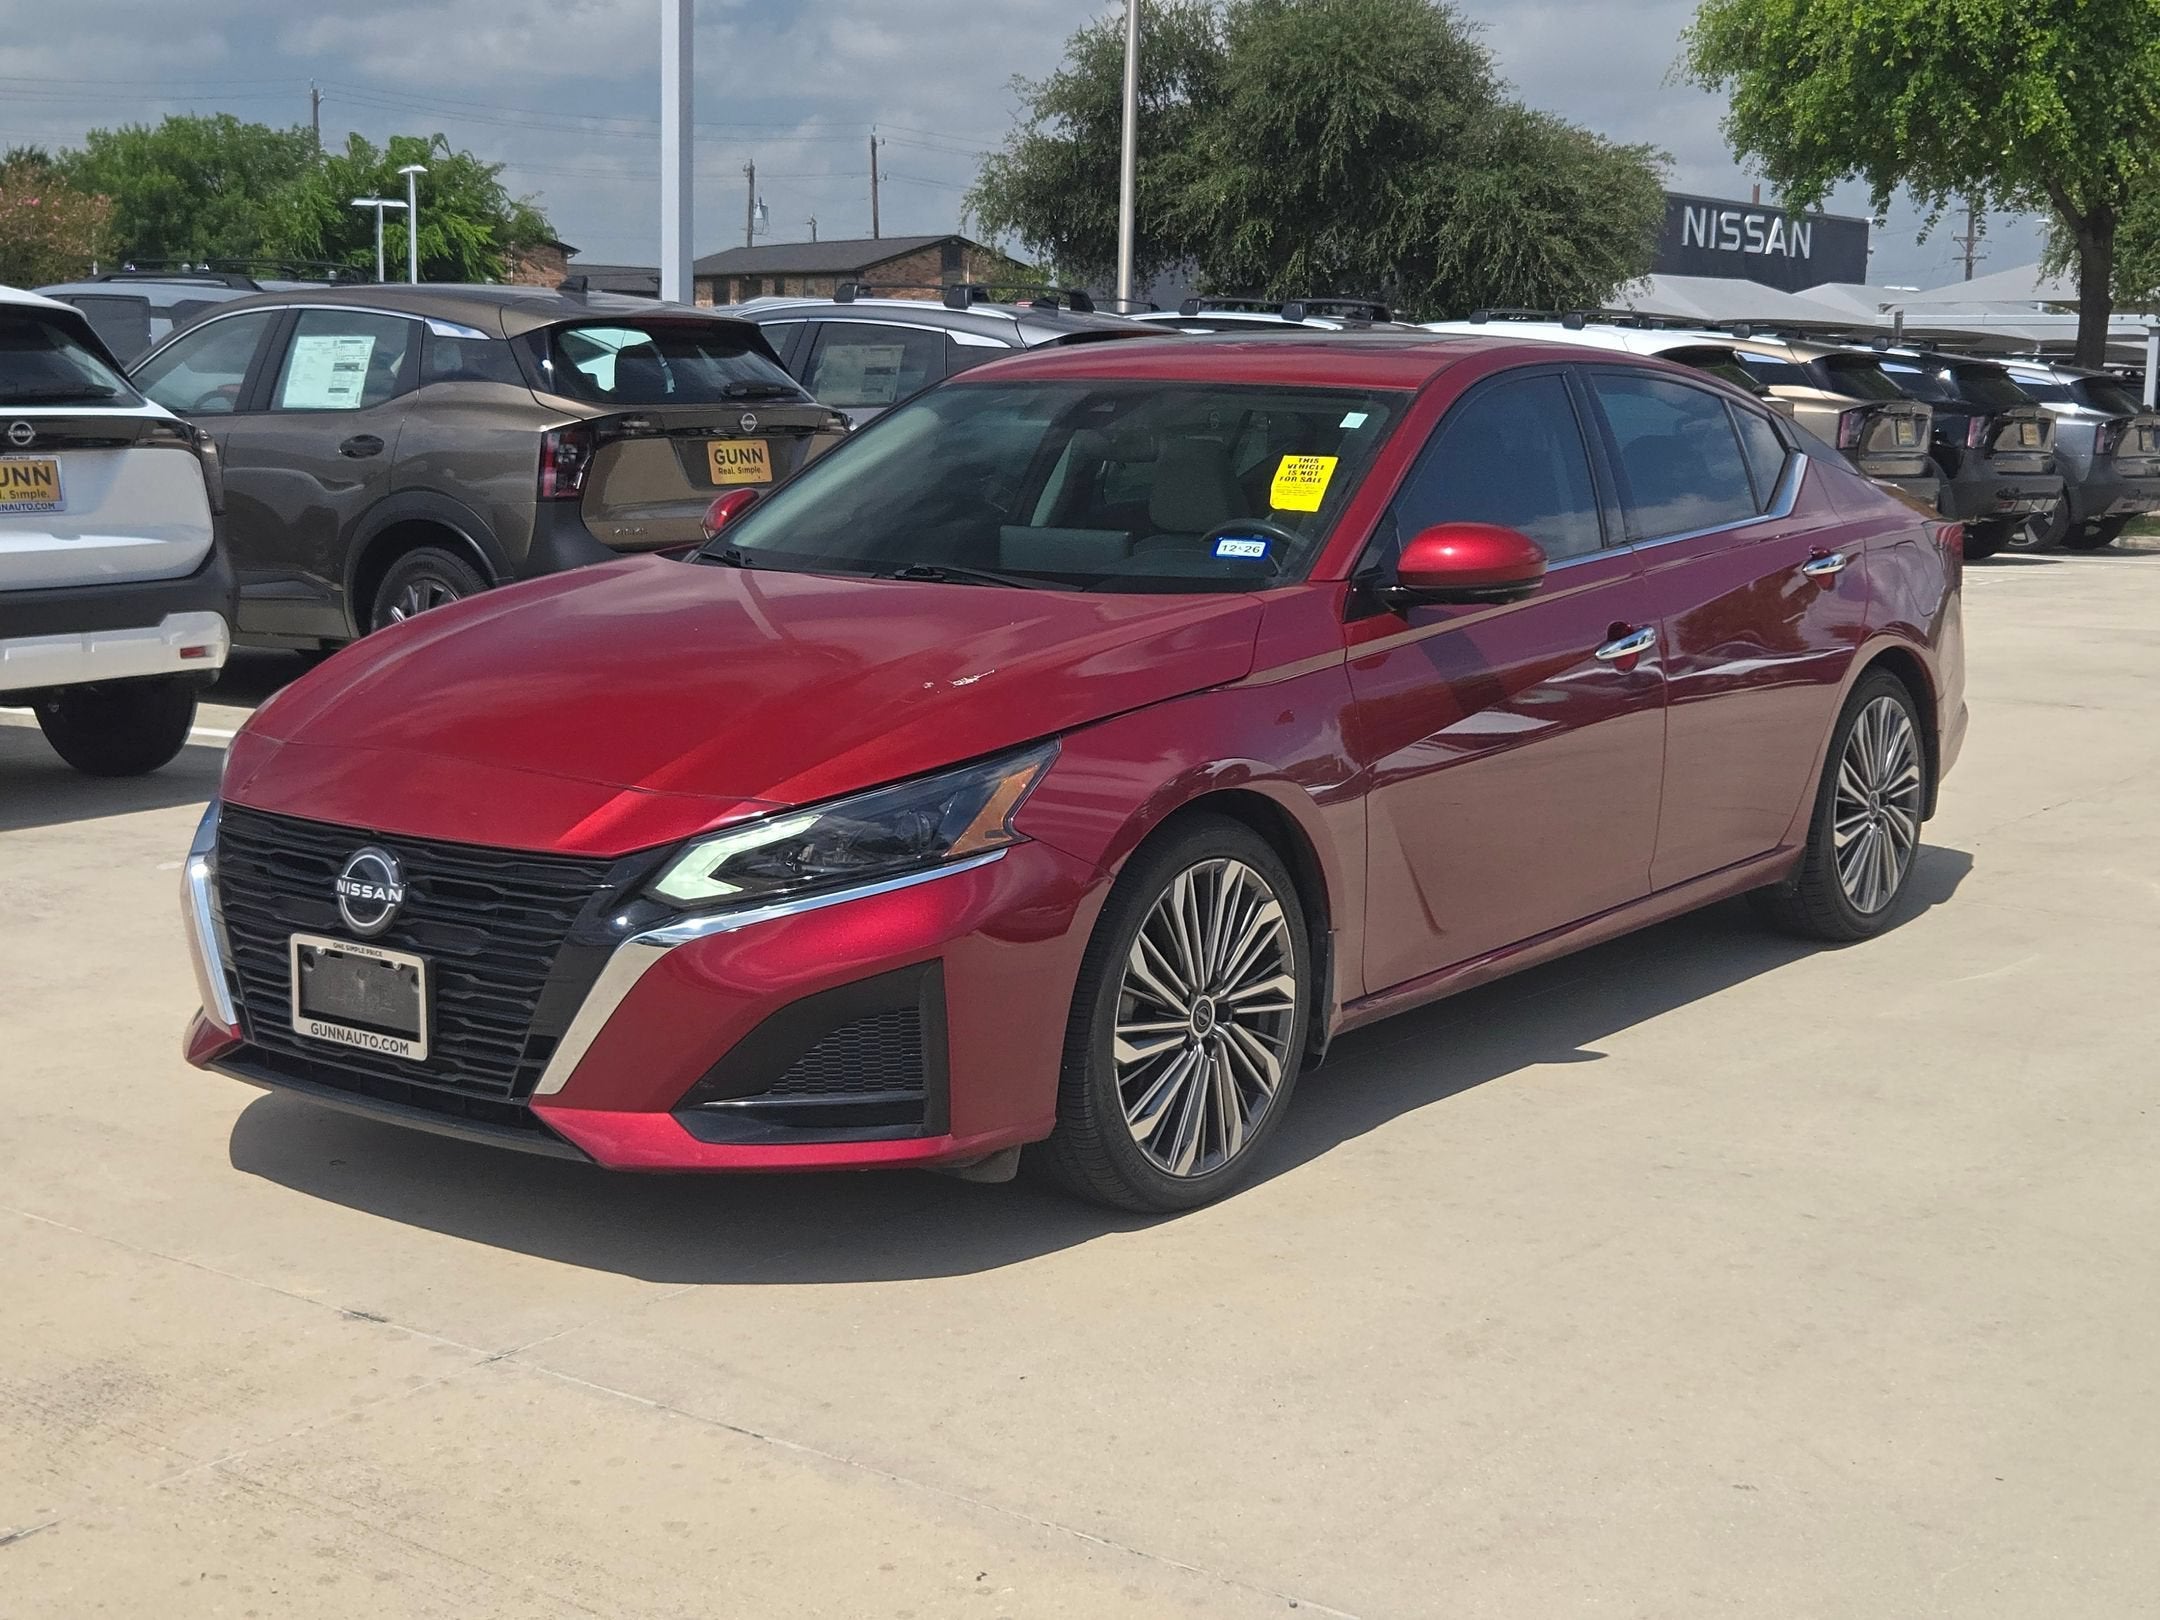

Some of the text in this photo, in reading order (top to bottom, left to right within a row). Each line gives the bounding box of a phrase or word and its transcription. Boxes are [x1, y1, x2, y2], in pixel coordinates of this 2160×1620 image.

[1681, 205, 1812, 260] NISSAN
[713, 448, 764, 465] GUNN
[1287, 463, 1325, 471] VEHICLE
[1299, 476, 1322, 484] SALE
[9, 488, 50, 500] Simple.
[0, 502, 56, 511] NAUTO.COM
[336, 879, 403, 902] NISSAN
[310, 1022, 409, 1056] GUNNAUTO.COM
